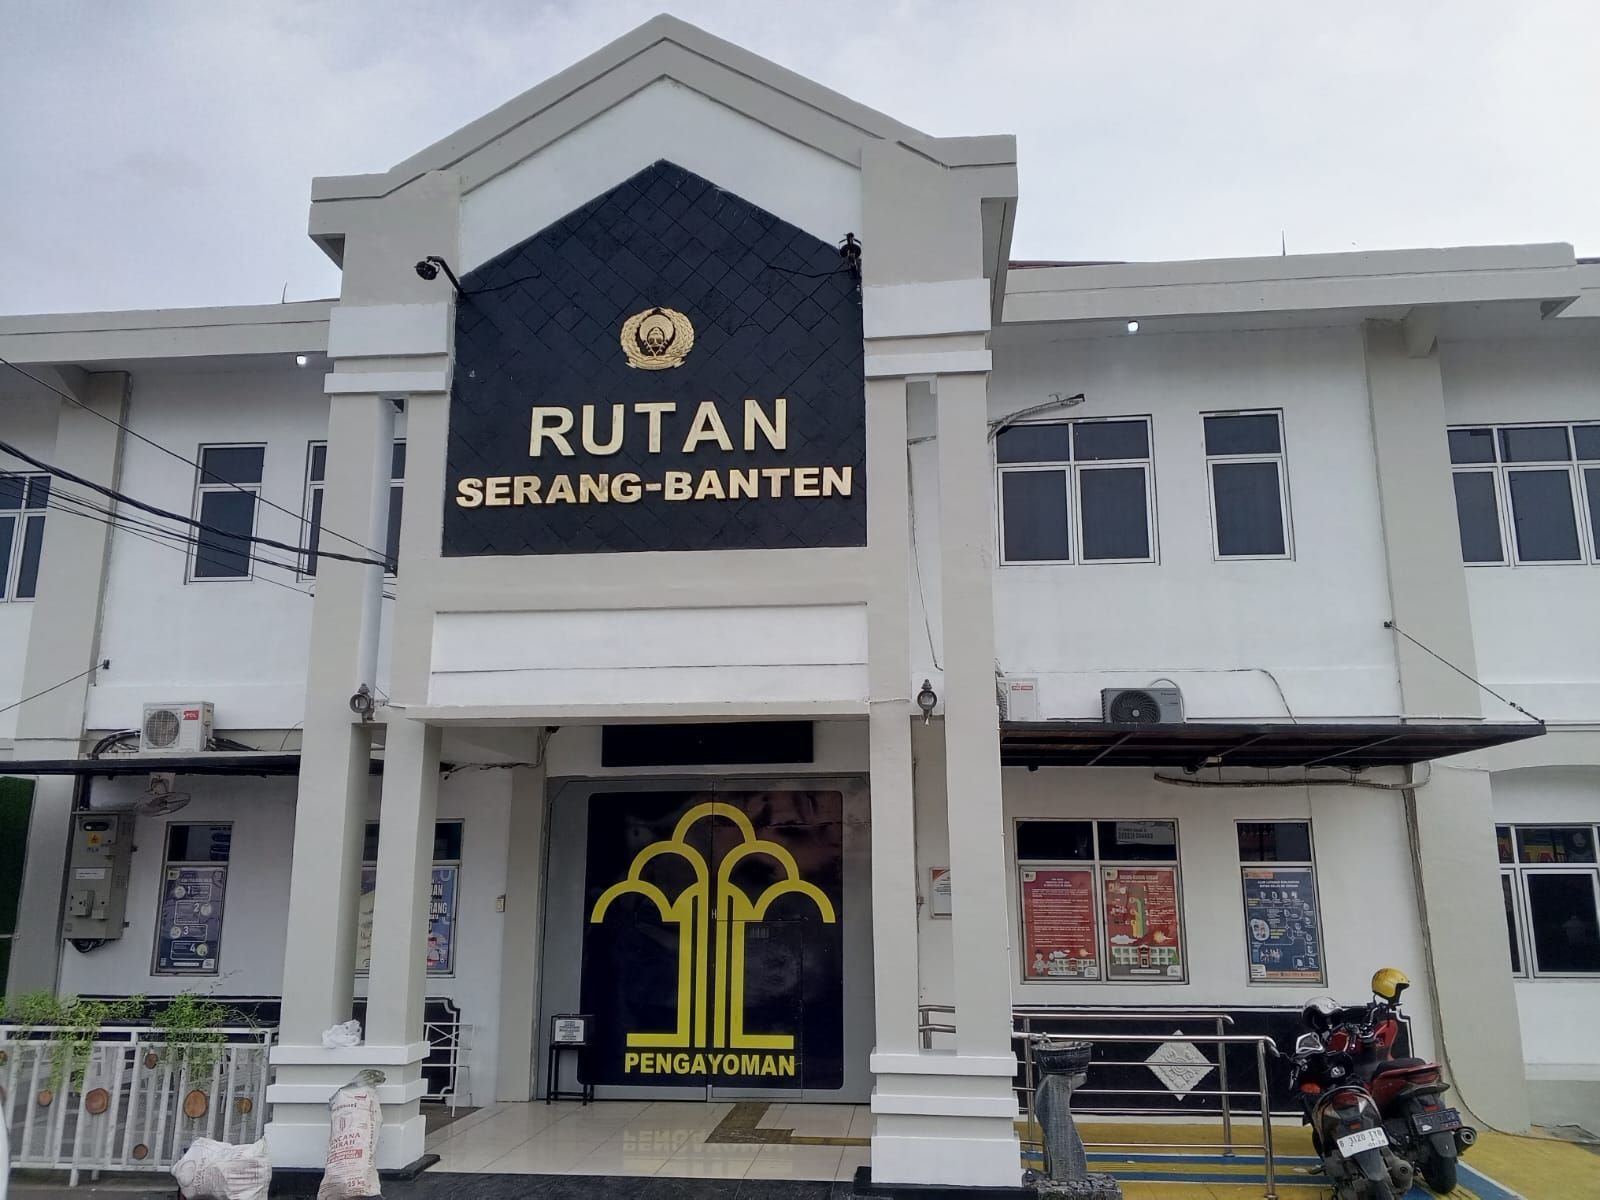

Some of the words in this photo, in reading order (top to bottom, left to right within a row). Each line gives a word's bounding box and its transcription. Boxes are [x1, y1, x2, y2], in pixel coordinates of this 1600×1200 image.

[529, 398, 788, 457] RUTAN
[456, 466, 853, 508] SERANG-BANTEN
[431, 884, 443, 896] AN
[193, 902, 200, 912] 2
[429, 902, 448, 914] RANG
[183, 926, 189, 935] 3
[189, 944, 196, 953] 4
[624, 1052, 795, 1076] PENGAYOMAN
